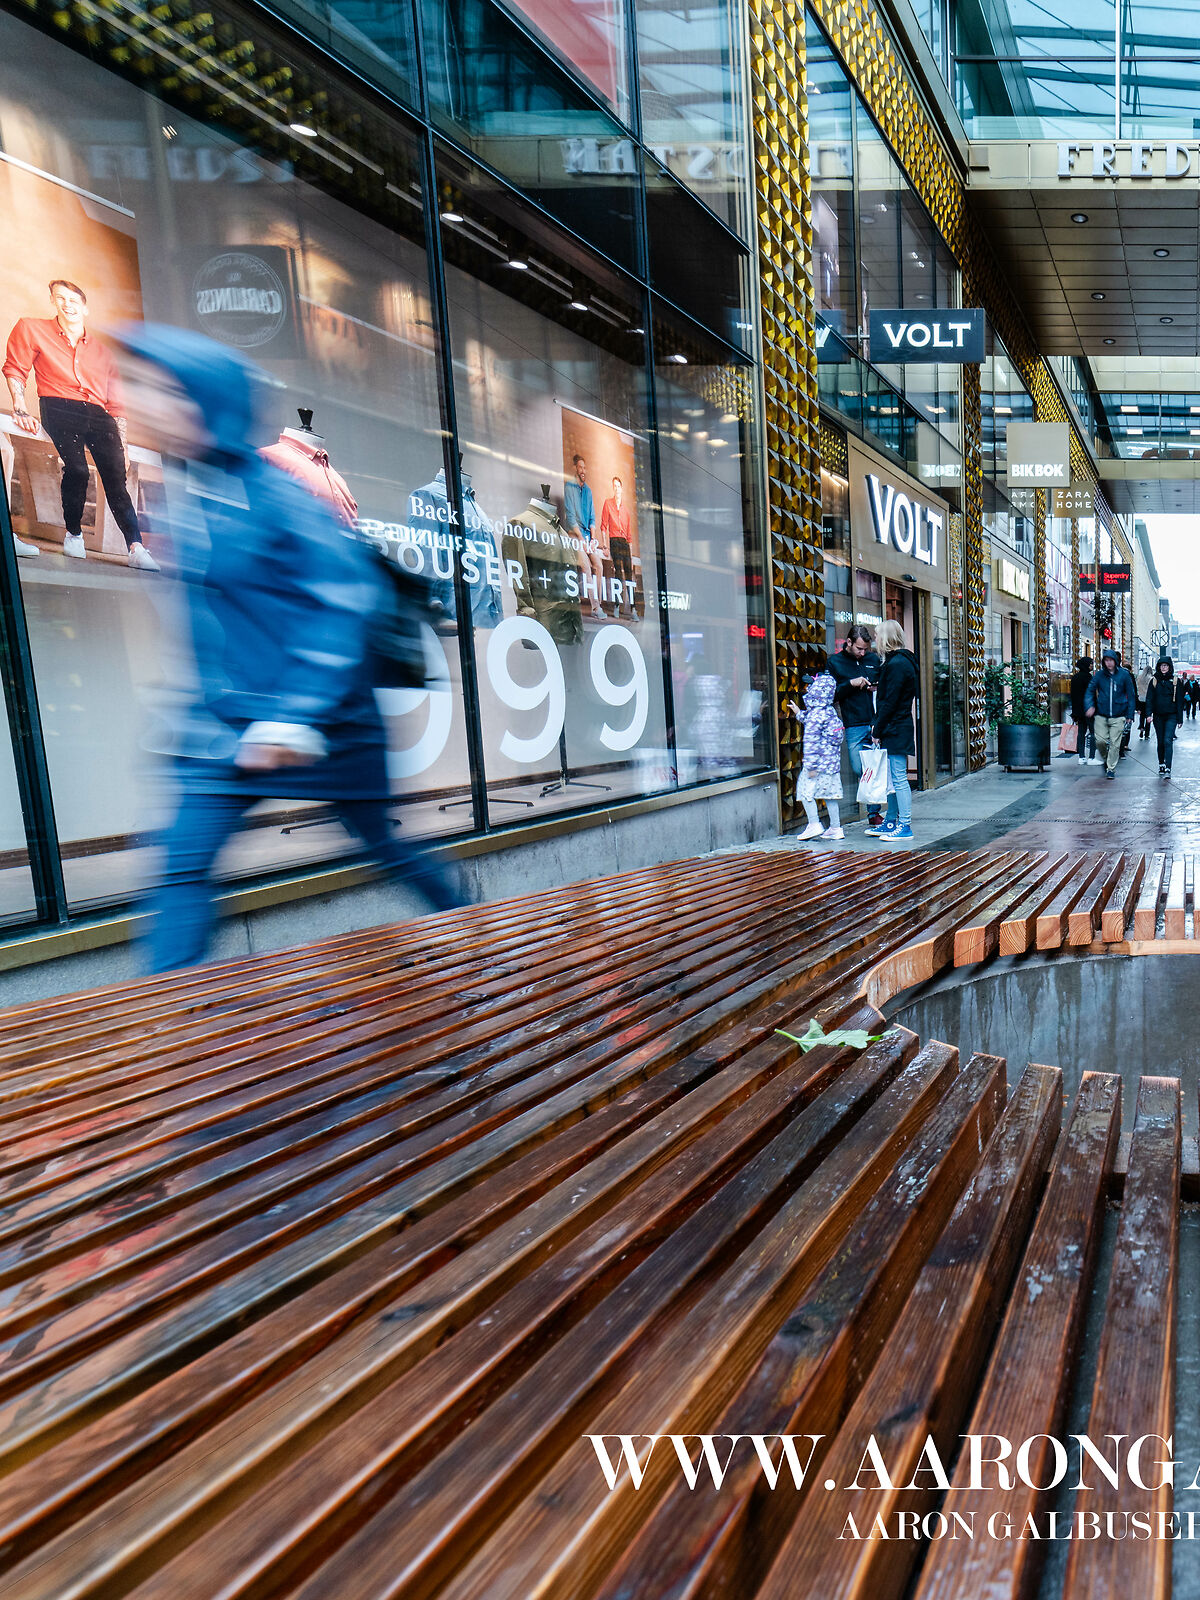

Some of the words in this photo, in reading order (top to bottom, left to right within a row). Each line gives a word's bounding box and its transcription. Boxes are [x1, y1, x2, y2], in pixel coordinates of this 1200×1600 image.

[883, 321, 972, 348] VOLT
[1011, 463, 1064, 478] BIKBOK
[1056, 501, 1092, 509] HOME
[1057, 491, 1091, 499] ZARA
[410, 496, 459, 527] Back
[463, 511, 487, 531] to
[489, 515, 539, 546] school
[541, 528, 557, 546] or
[865, 473, 943, 568] VOLT
[564, 569, 638, 605] SHIRT
